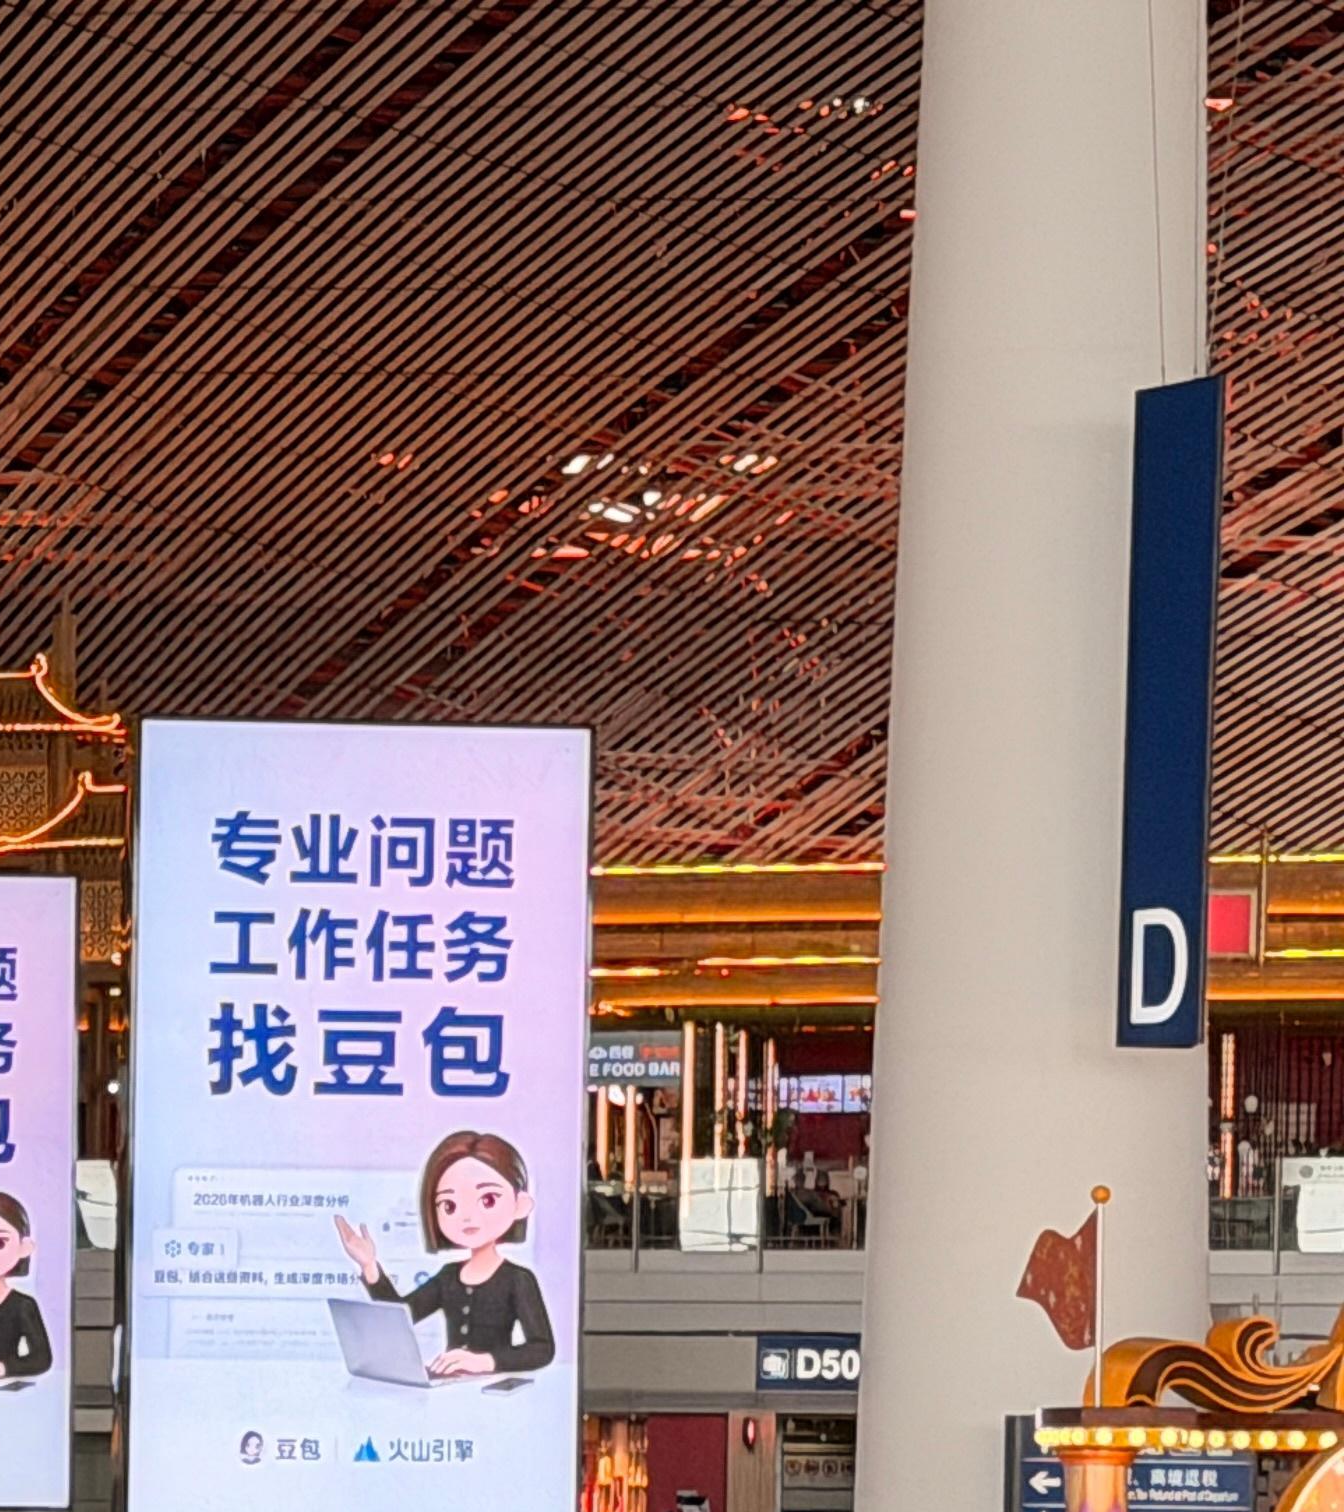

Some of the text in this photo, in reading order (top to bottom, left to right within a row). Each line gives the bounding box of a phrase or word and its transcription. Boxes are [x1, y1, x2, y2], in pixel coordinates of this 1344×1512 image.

[211, 810, 515, 889] 专业问题
[209, 907, 514, 984] 工作任务
[1130, 907, 1189, 1025] D
[207, 1002, 511, 1098] 找豆包
[602, 1062, 645, 1077] FOOD
[648, 1062, 681, 1077] BAR
[796, 1347, 861, 1381] D50
[275, 1437, 474, 1463] 豆包 火山引擎
